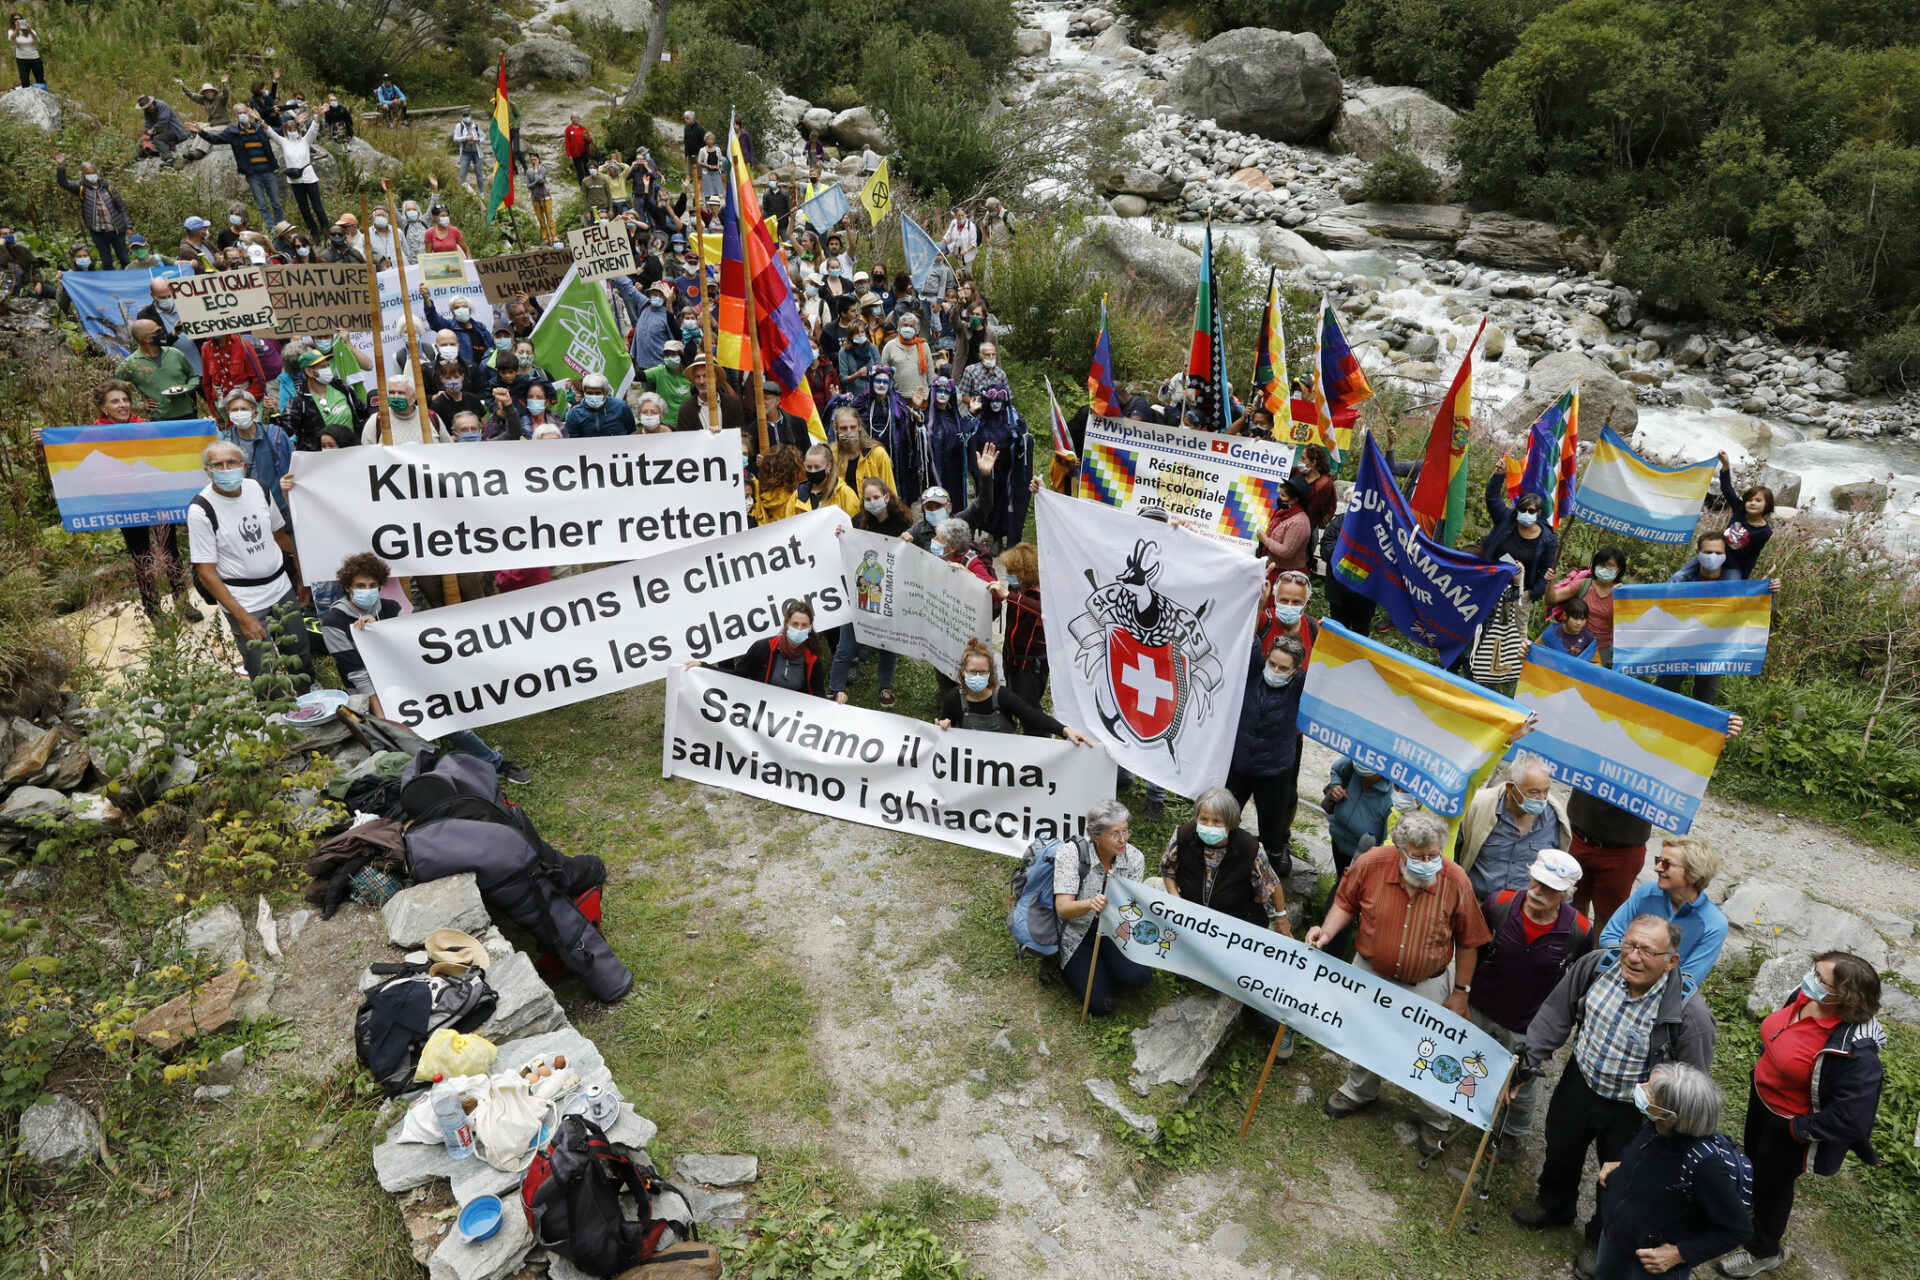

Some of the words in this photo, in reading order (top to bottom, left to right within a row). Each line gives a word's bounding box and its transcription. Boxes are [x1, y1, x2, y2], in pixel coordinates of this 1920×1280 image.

[573, 237, 628, 260] GLACIER
[583, 226, 609, 245] FEU
[286, 268, 368, 286] NATURE
[518, 266, 549, 280] POUR
[589, 253, 630, 274] TRIENT
[168, 271, 265, 299] POLITIQUE
[434, 286, 447, 297] du
[202, 292, 238, 311] ECO
[181, 305, 275, 335] RESPONSABLE?
[1092, 416, 1207, 450] #WiphalaPride
[1230, 444, 1287, 468] Genève
[369, 462, 509, 502] Klima
[524, 452, 740, 493] schützen,
[1148, 457, 1220, 483] Résistance
[1135, 475, 1226, 504] anti-coloniale
[72, 509, 186, 530] GLETSCHER-INITI
[1139, 494, 1213, 520] anti-raciste
[371, 515, 603, 561] Gletscher
[618, 505, 742, 543] retten
[1571, 501, 1687, 543] GLETSCHER-INITIATIVE
[246, 541, 266, 555] WWF
[1238, 539, 1253, 547] Earth
[1373, 523, 1398, 565] BUE
[883, 551, 896, 618] GPCLIMAT-GE
[903, 581, 924, 591] nous
[909, 591, 924, 600] une
[417, 590, 622, 666] Sauvons
[632, 574, 671, 609] le
[682, 534, 817, 594] climat,
[1092, 588, 1118, 612] SAC
[857, 621, 888, 634] Association
[1176, 608, 1203, 646] CAS
[398, 656, 598, 728] sauvons
[608, 634, 673, 675] les
[1621, 661, 1753, 676] GLETSCHER-INITIATIVE
[700, 687, 885, 764] Salviamo
[897, 733, 921, 768] il
[931, 746, 1058, 796] clima,
[1308, 721, 1352, 754] POUR
[1355, 744, 1388, 772] LES
[1390, 762, 1460, 815] GLACIERS
[1392, 736, 1466, 791] INITIATIVE
[672, 737, 846, 802] salviamo
[859, 776, 869, 809] i
[879, 789, 1087, 843] ghiacciai!
[1561, 767, 1596, 792] LES
[1597, 782, 1681, 832] GLACIERS
[1598, 759, 1689, 812] INITIATIVE
[1149, 900, 1308, 971] Grands-parents
[1313, 963, 1368, 996] pour
[1372, 986, 1393, 1009] le
[1401, 1002, 1468, 1046] climat
[1236, 974, 1344, 1030] GPclimat.ch
